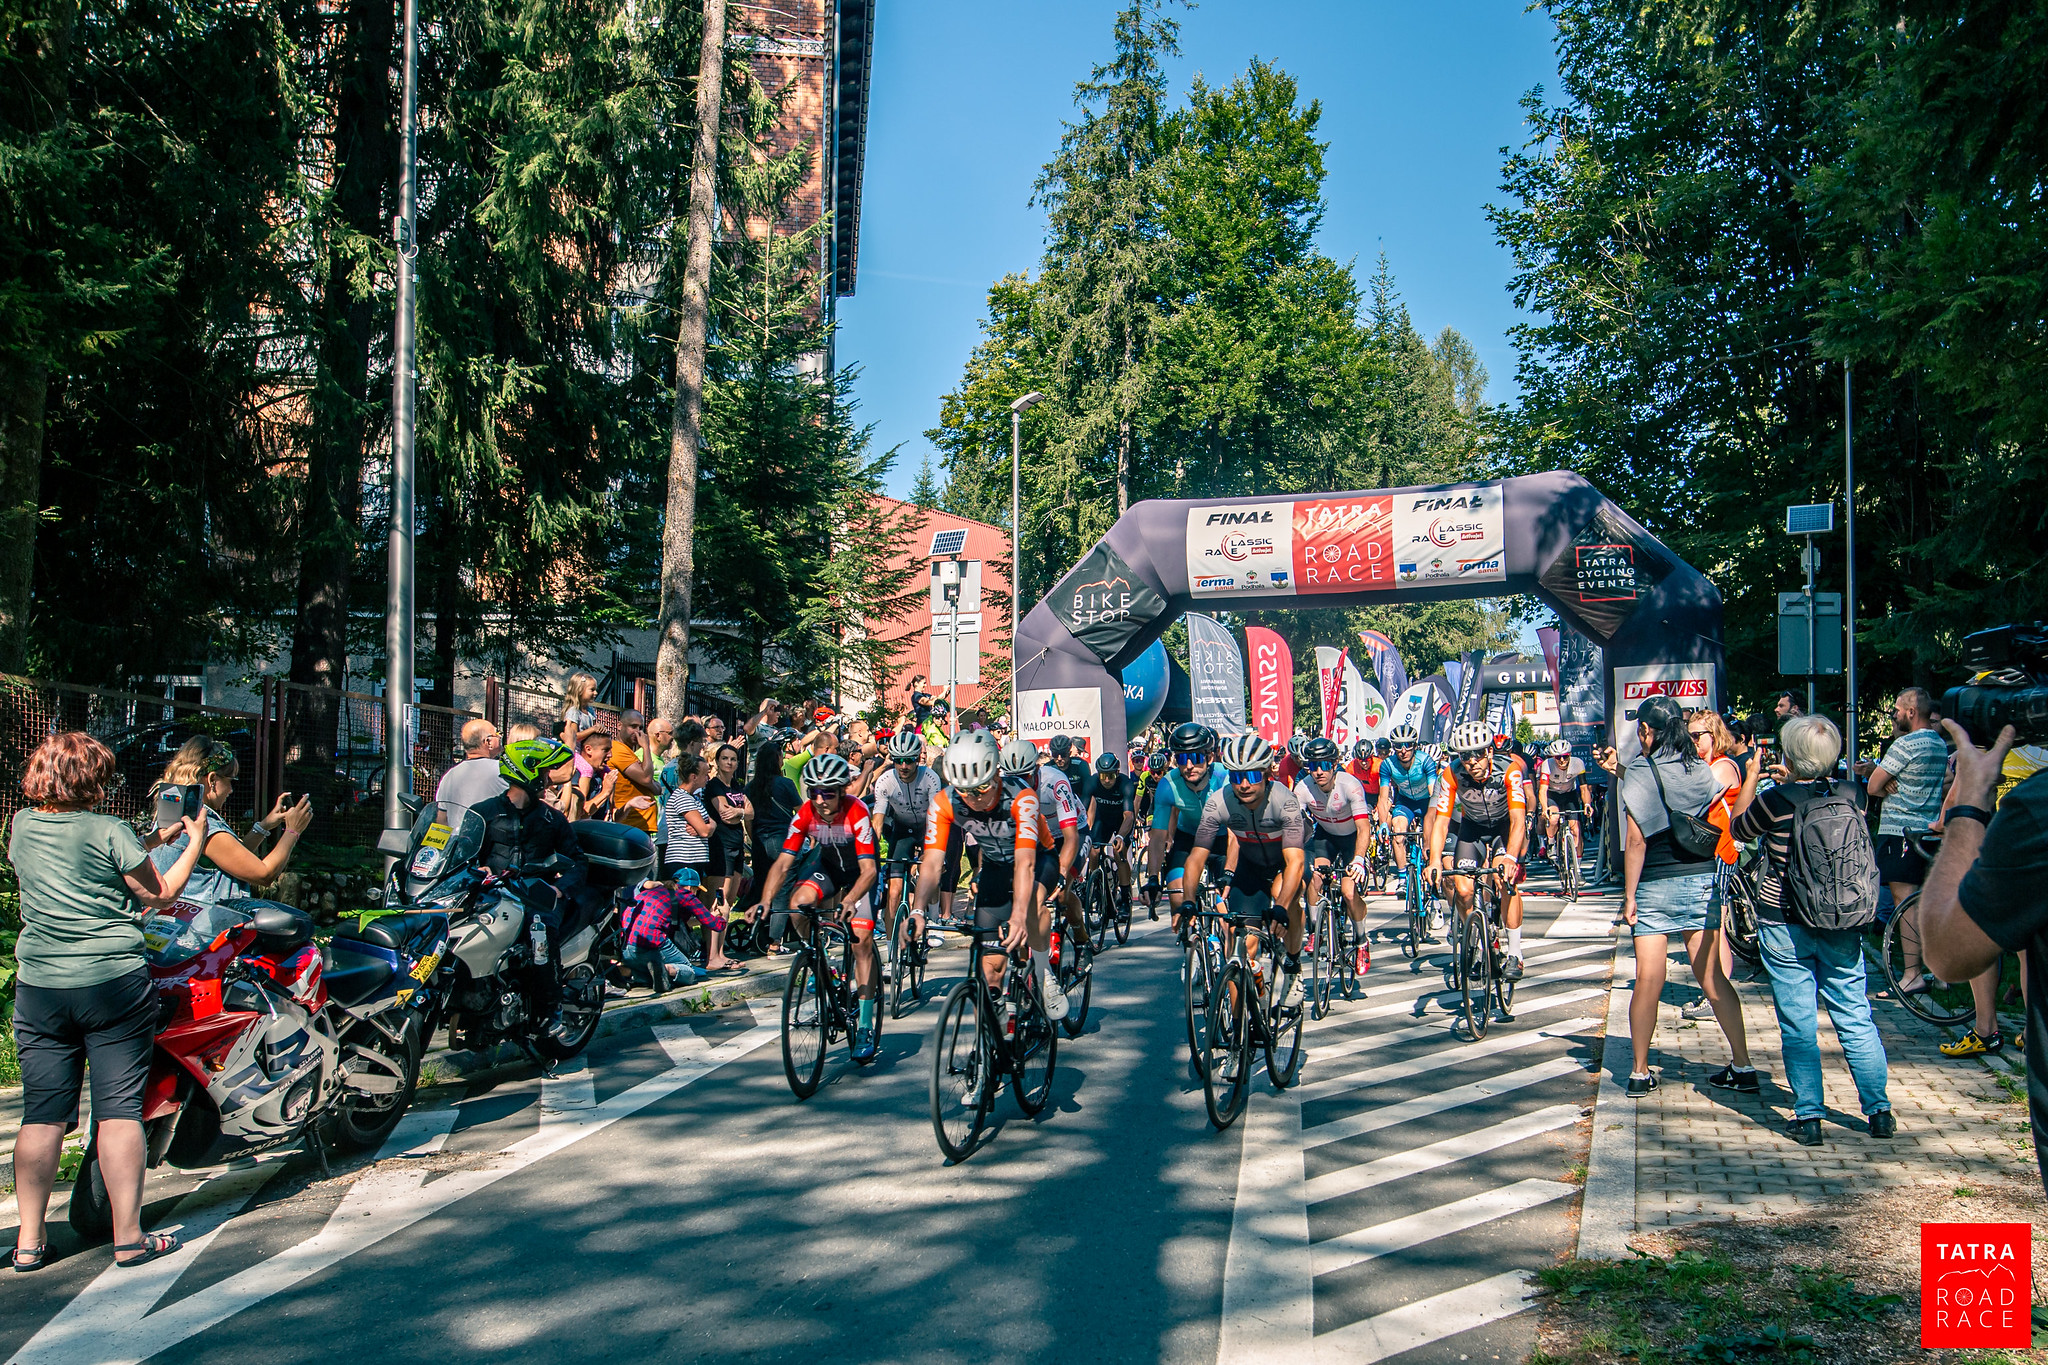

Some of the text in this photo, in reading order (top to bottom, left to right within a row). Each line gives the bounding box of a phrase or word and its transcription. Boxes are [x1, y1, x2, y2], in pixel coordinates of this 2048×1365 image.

[1412, 496, 1483, 512] FINAŁ
[1206, 511, 1273, 526] FINAŁ
[1305, 503, 1382, 525] TATRA
[1305, 542, 1382, 564] ROAD
[1584, 558, 1627, 567] TATRA
[1306, 563, 1382, 583] RACE
[1577, 567, 1635, 578] CYCLING
[1578, 578, 1635, 589] EVENTS
[1073, 593, 1131, 610] BIKE
[1073, 610, 1131, 626] STOP
[1626, 681, 1704, 697] DT SWISS
[1023, 720, 1091, 732] MAŁOPOLSKA
